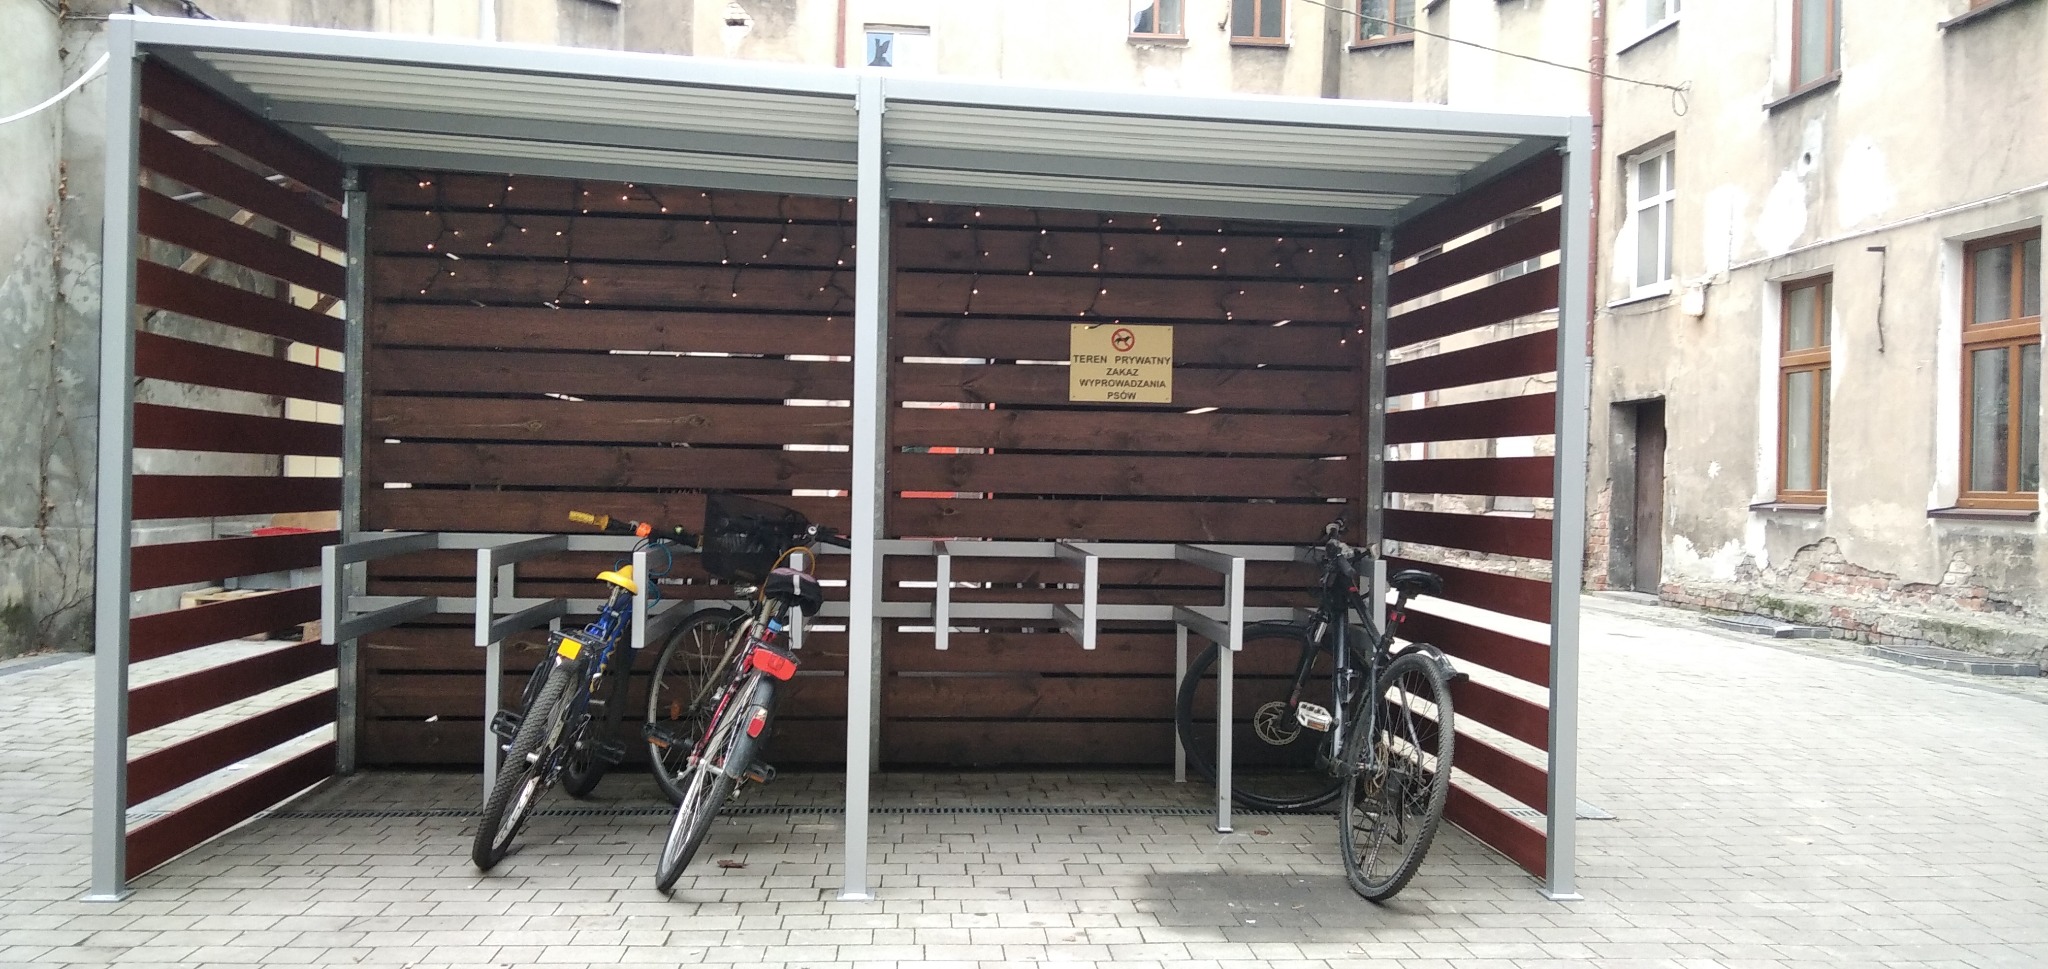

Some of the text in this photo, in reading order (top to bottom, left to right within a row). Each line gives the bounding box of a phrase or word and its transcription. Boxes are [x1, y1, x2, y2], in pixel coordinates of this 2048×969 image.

[1073, 354, 1171, 365] TEREN PRYWATNY
[1106, 368, 1139, 376] ZAKAZ
[1079, 379, 1166, 388] WYPROWADZANIA
[1107, 390, 1137, 400] PSÓW
